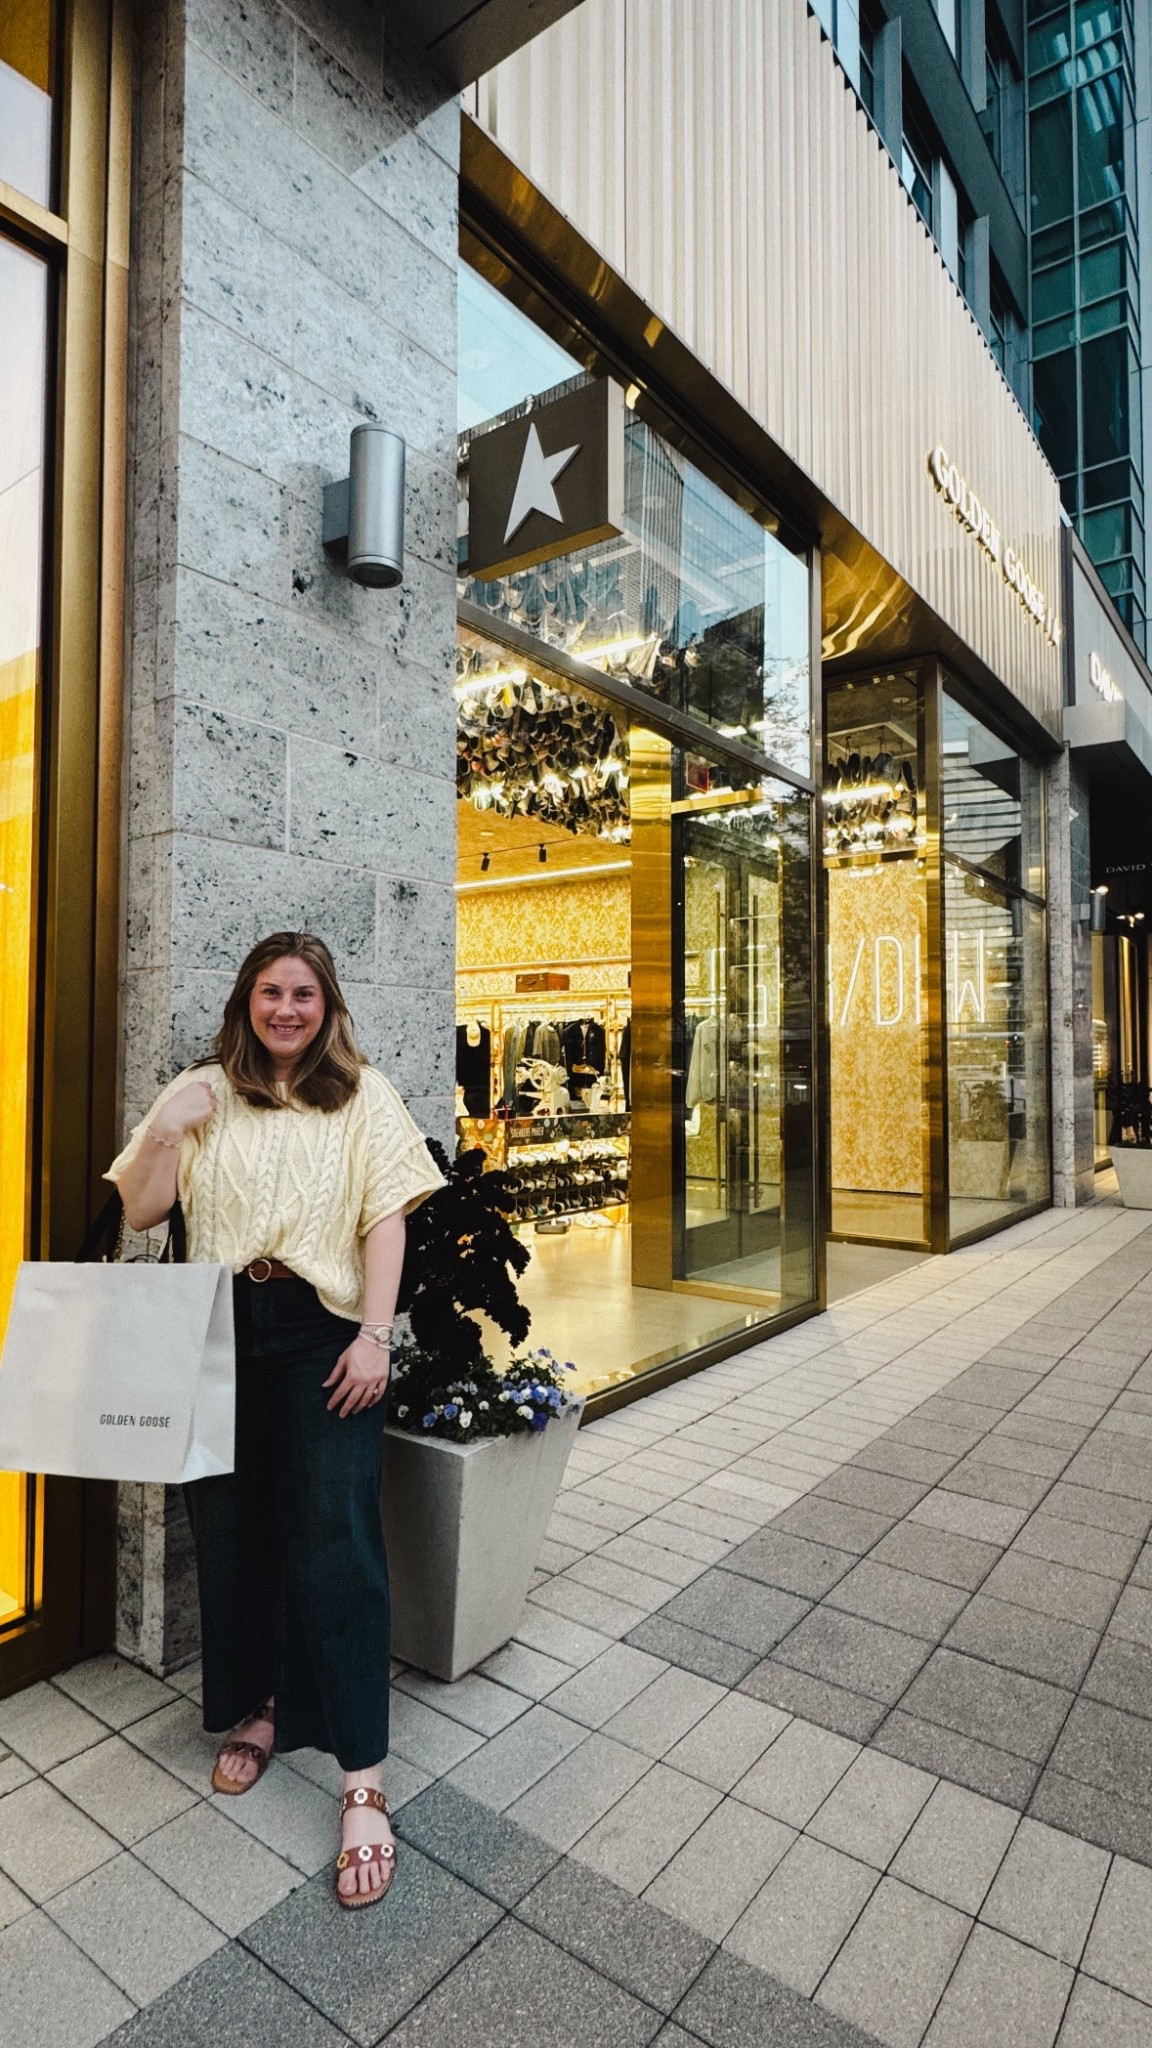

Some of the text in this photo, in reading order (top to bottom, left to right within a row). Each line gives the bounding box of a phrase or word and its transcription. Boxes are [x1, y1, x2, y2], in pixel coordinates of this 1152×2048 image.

[931, 445, 1045, 624] GOLDEN GOOSE
[1106, 864, 1146, 874] DAVID
[100, 1414, 171, 1428] GOLDEN GOOSE
